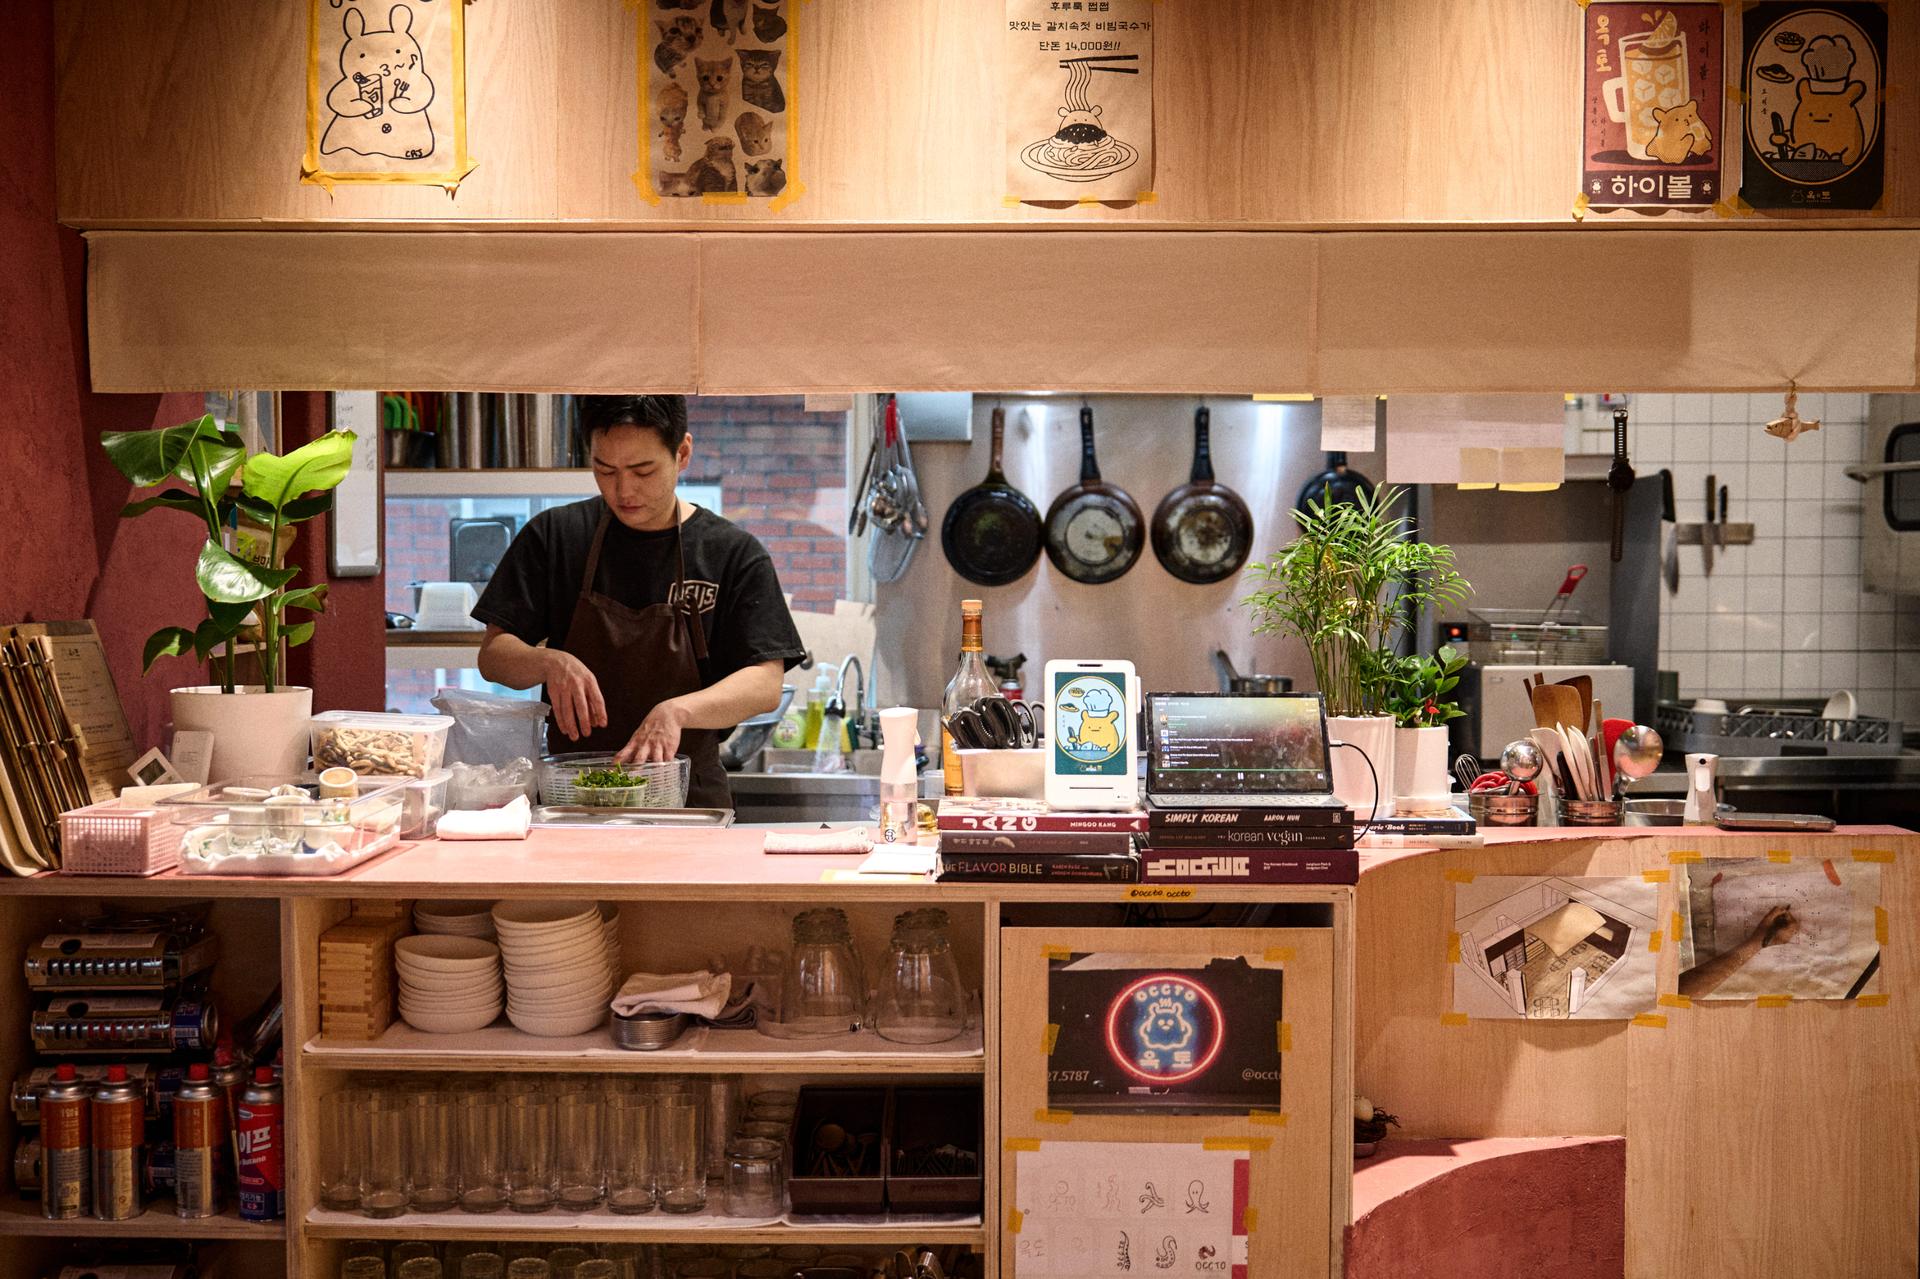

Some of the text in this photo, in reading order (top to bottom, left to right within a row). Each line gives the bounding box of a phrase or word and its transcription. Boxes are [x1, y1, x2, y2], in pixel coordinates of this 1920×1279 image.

[1009, 21, 1152, 31] 맛있는 갈치속젓 비빔국수가
[1039, 41, 1121, 52] 단돈 14,000원!!
[1611, 175, 1693, 199] 하이볼
[1165, 814, 1239, 823] SIMPLY KOREAN
[1228, 830, 1264, 841] korean
[1267, 830, 1303, 846] vegan
[959, 862, 1006, 872] FLAVOR
[1009, 864, 1042, 874] BIBLE
[1135, 985, 1195, 1002] OCCTO
[1242, 1068, 1282, 1081] @occt
[1195, 1261, 1226, 1271] OCCTO
